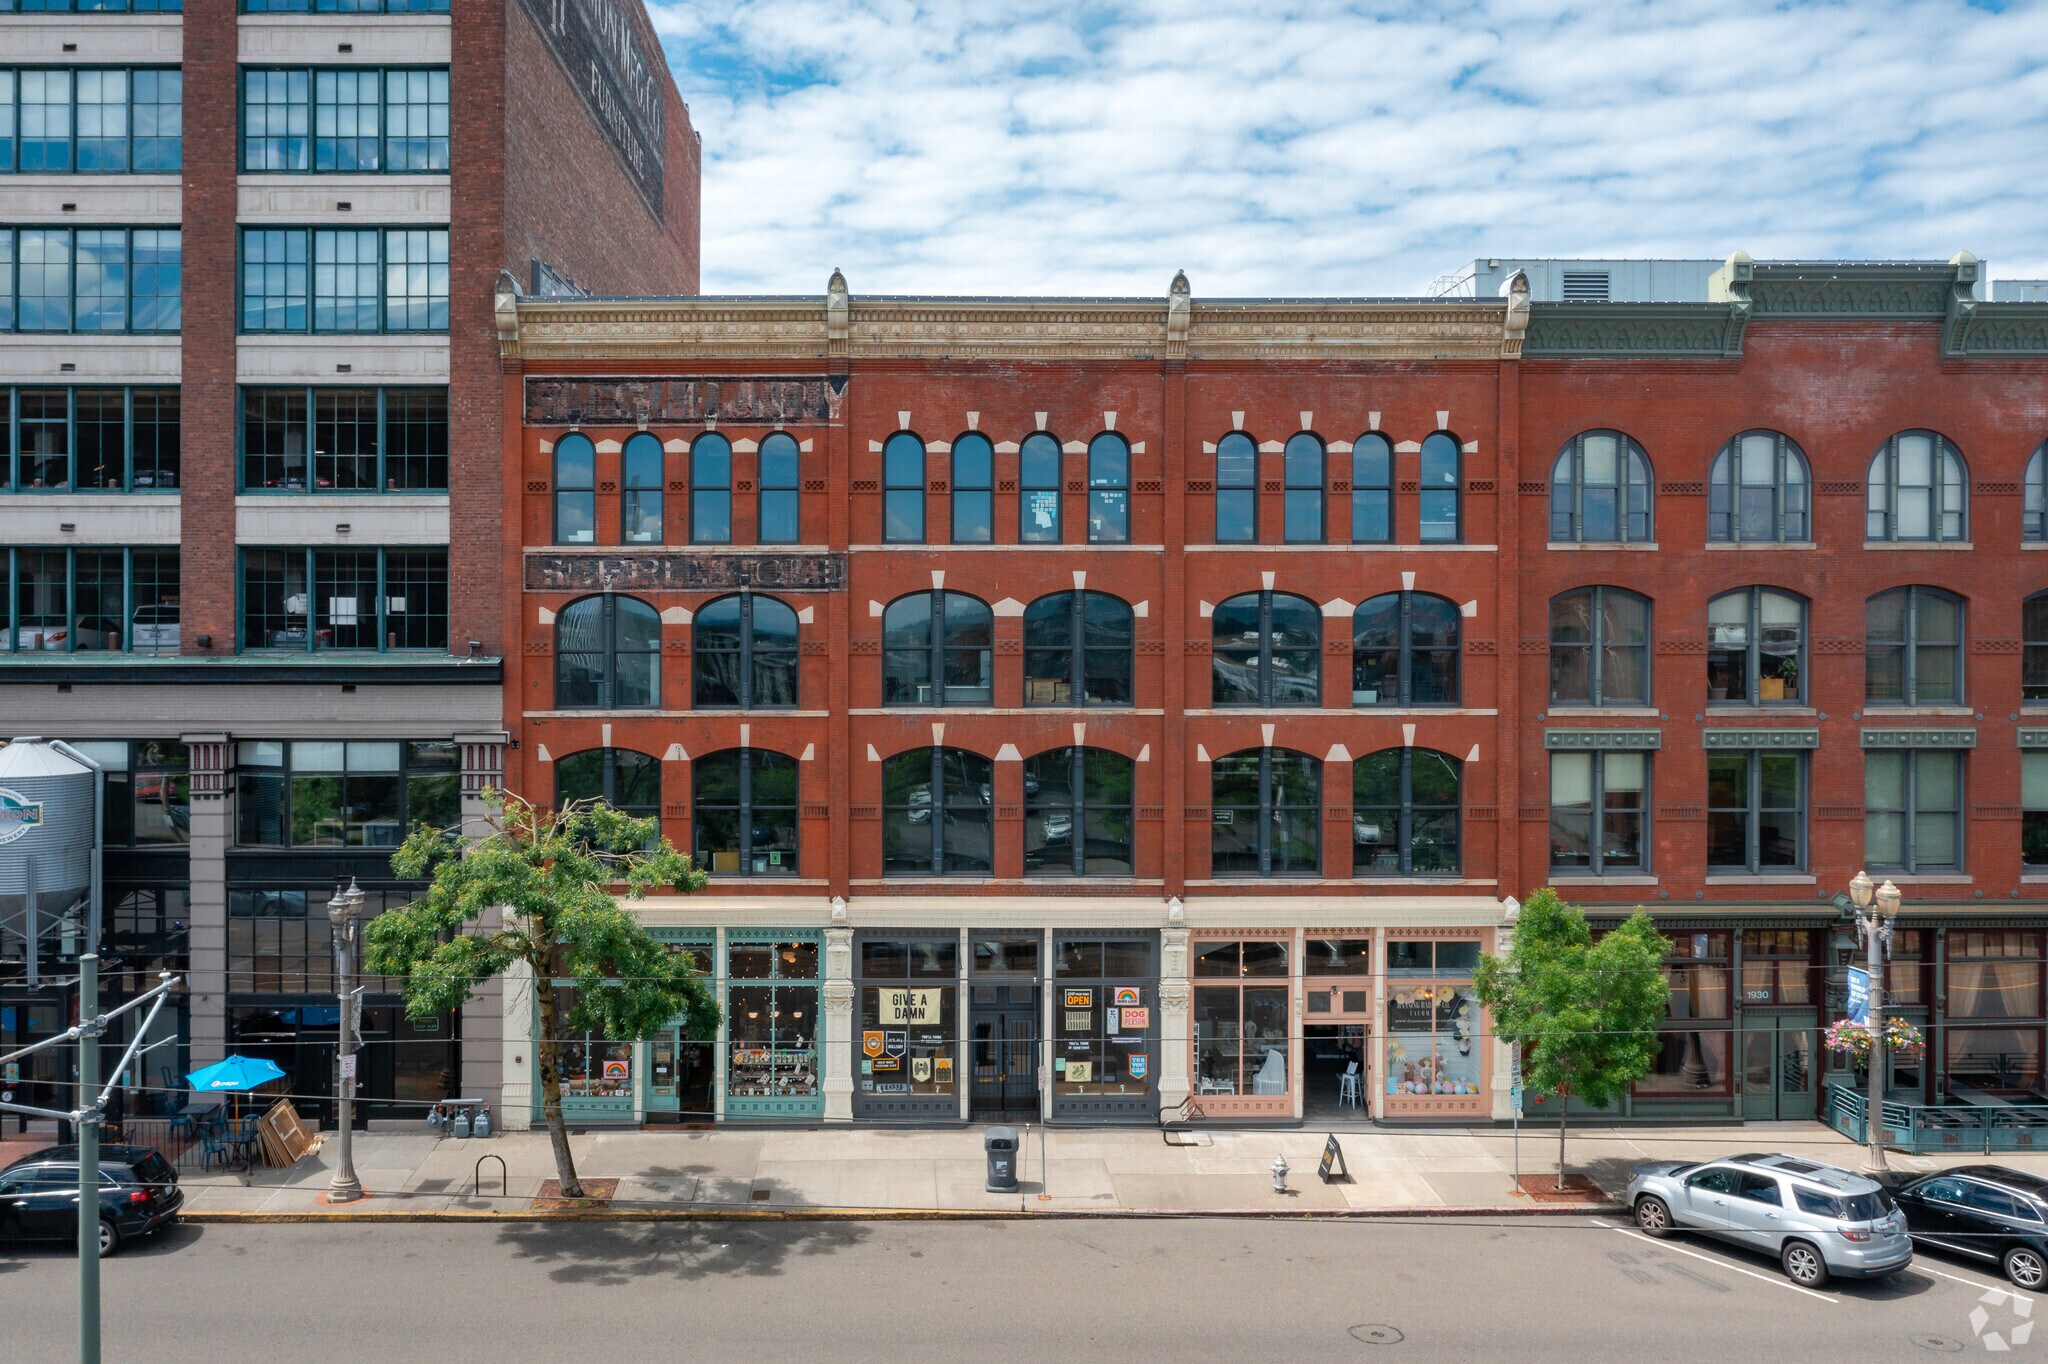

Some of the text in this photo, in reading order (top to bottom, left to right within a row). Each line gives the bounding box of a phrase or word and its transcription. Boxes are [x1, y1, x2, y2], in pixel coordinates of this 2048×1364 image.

[591, 60, 645, 181] FURNITURE
[1747, 990, 1769, 999] 1930
[892, 994, 927, 1006] GIVE A
[1067, 996, 1090, 1005] OPEN
[894, 1007, 925, 1019] DAMN
[1125, 1010, 1145, 1018] DOG
[1125, 1018, 1146, 1026] PERSON
